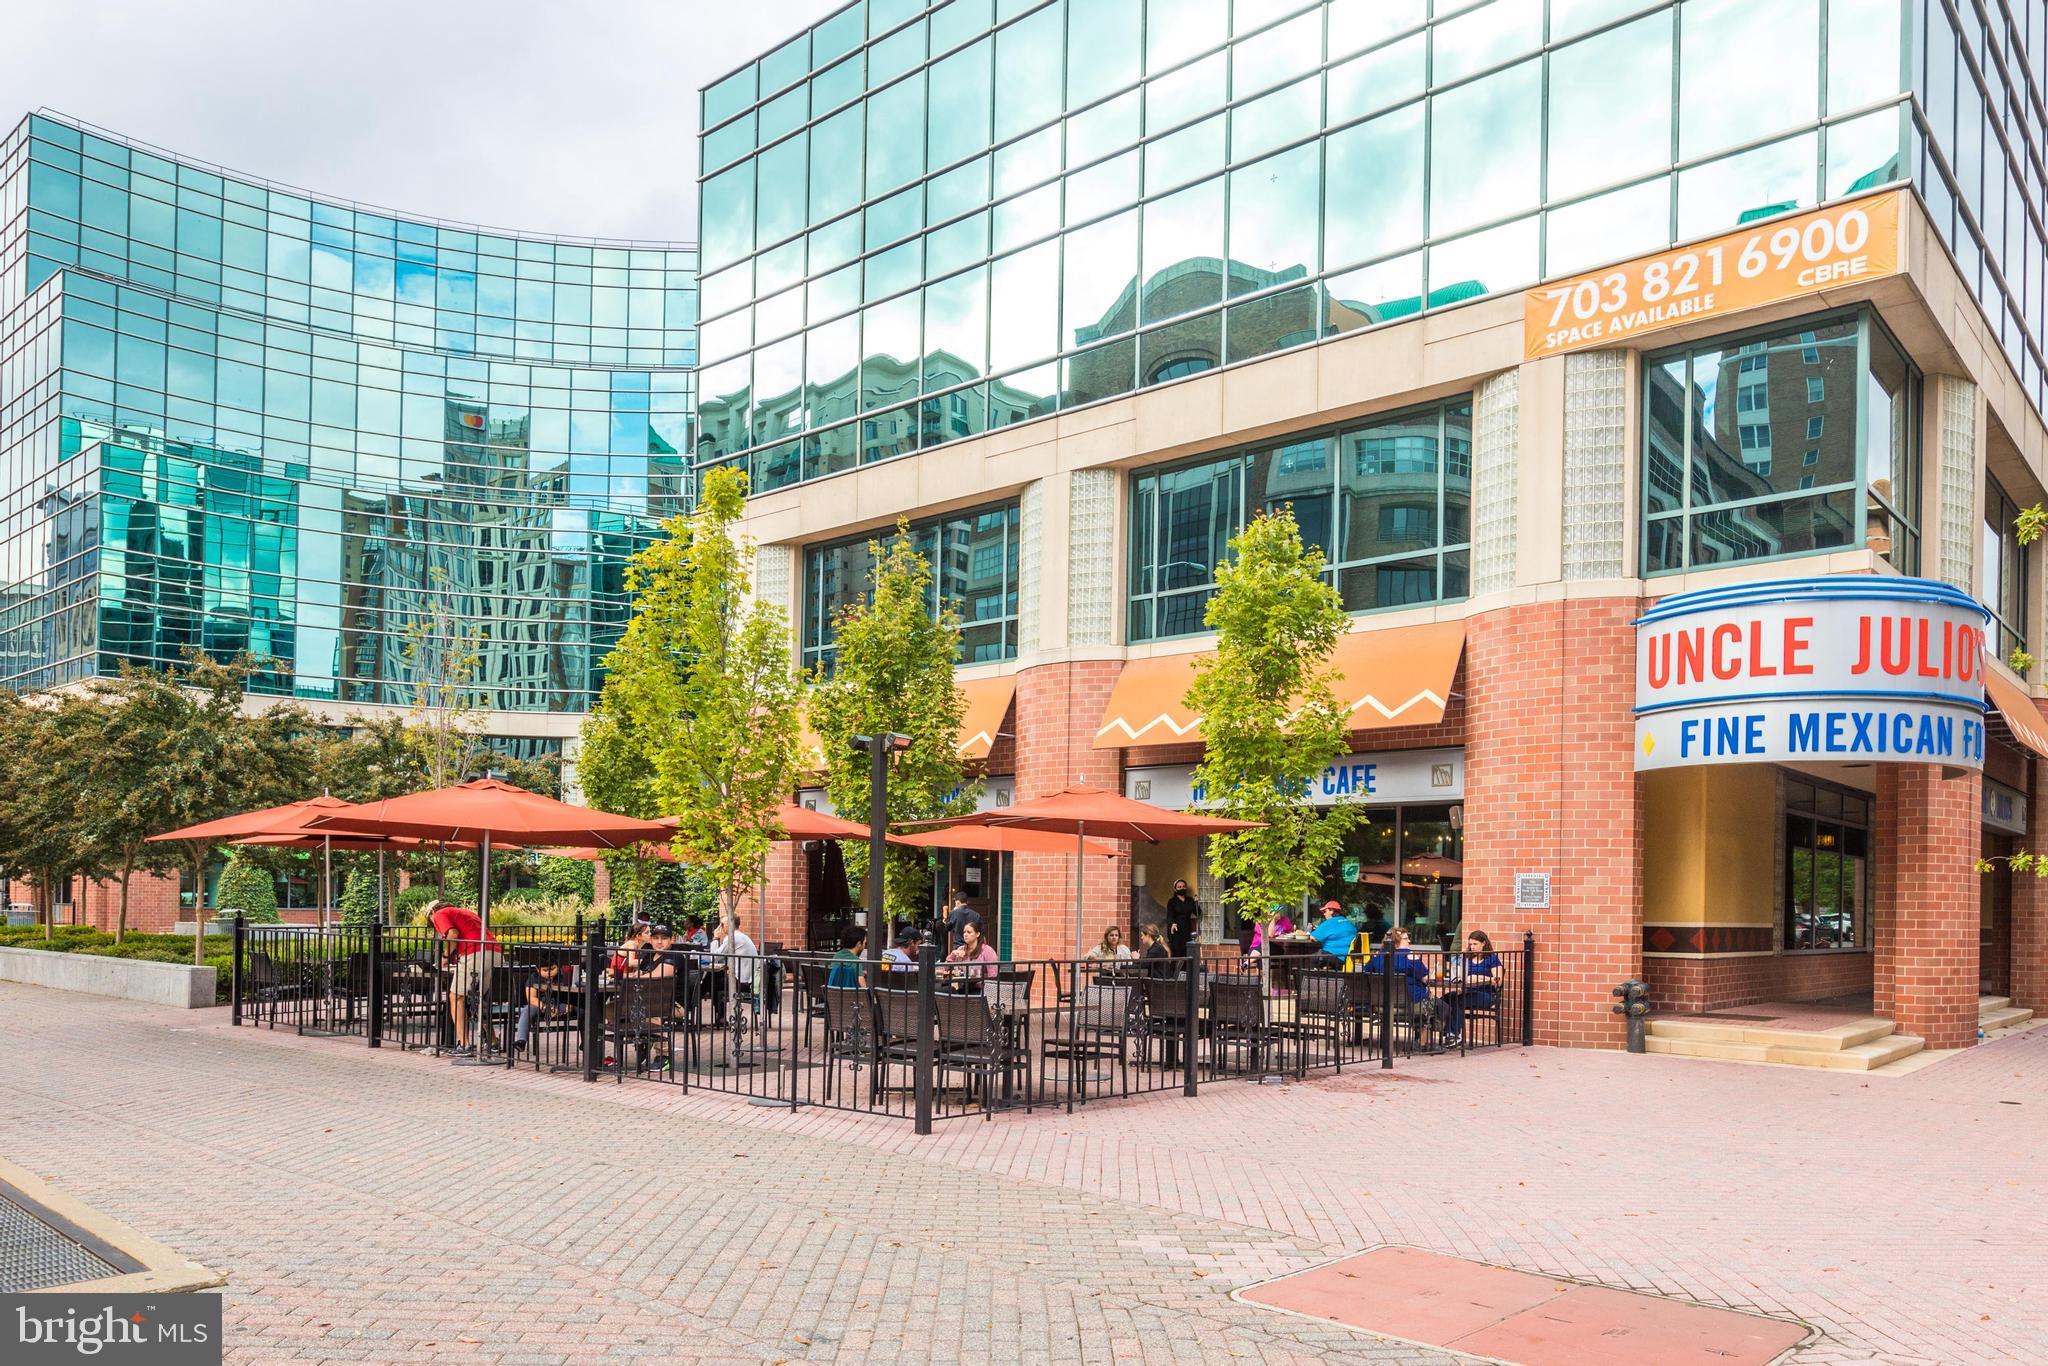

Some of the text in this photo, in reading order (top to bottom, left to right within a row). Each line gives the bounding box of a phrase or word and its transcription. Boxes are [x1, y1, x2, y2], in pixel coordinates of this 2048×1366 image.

[1546, 209, 1869, 328] 703 821 6900
[1797, 254, 1869, 288] CBRE
[1545, 293, 1715, 349] SPACE AVAILABLE
[1647, 615, 1986, 690] UNCLE JULIO'S
[1680, 714, 1766, 759] FINE
[1788, 712, 1953, 756] MEXICAN
[1322, 763, 1377, 796] CAFE
